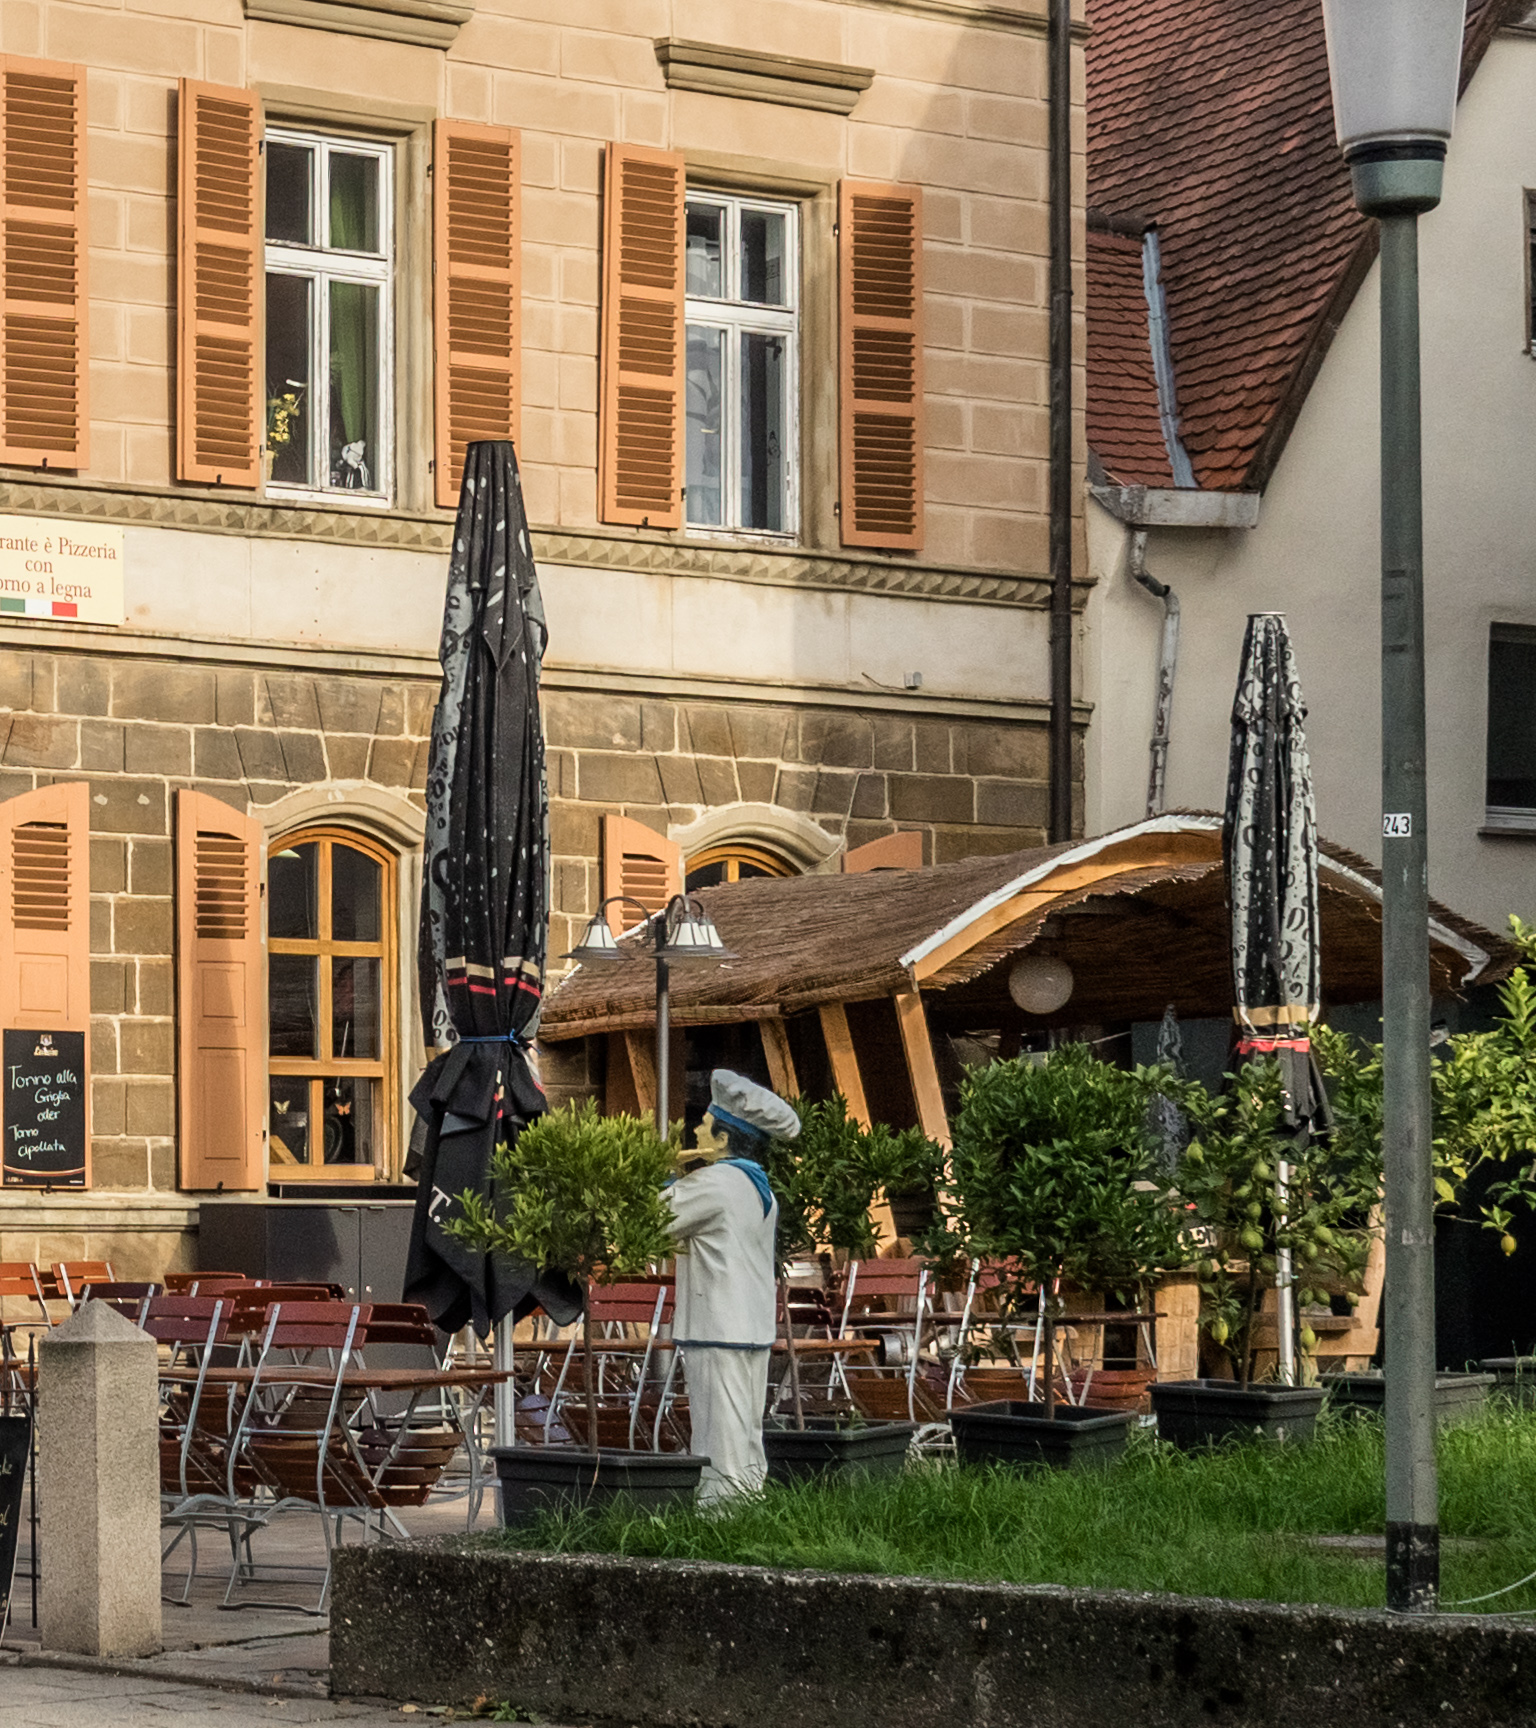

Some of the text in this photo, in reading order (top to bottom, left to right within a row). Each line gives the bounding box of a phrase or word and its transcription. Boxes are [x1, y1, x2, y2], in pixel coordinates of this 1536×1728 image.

[44, 536, 53, 554] è
[58, 536, 117, 560] Pizzeria
[25, 558, 54, 573] con
[36, 581, 46, 594] a
[51, 576, 93, 602] legna
[1383, 816, 1410, 834] 243
[8, 1064, 77, 1090] Tonno alla
[37, 1108, 61, 1122] oder
